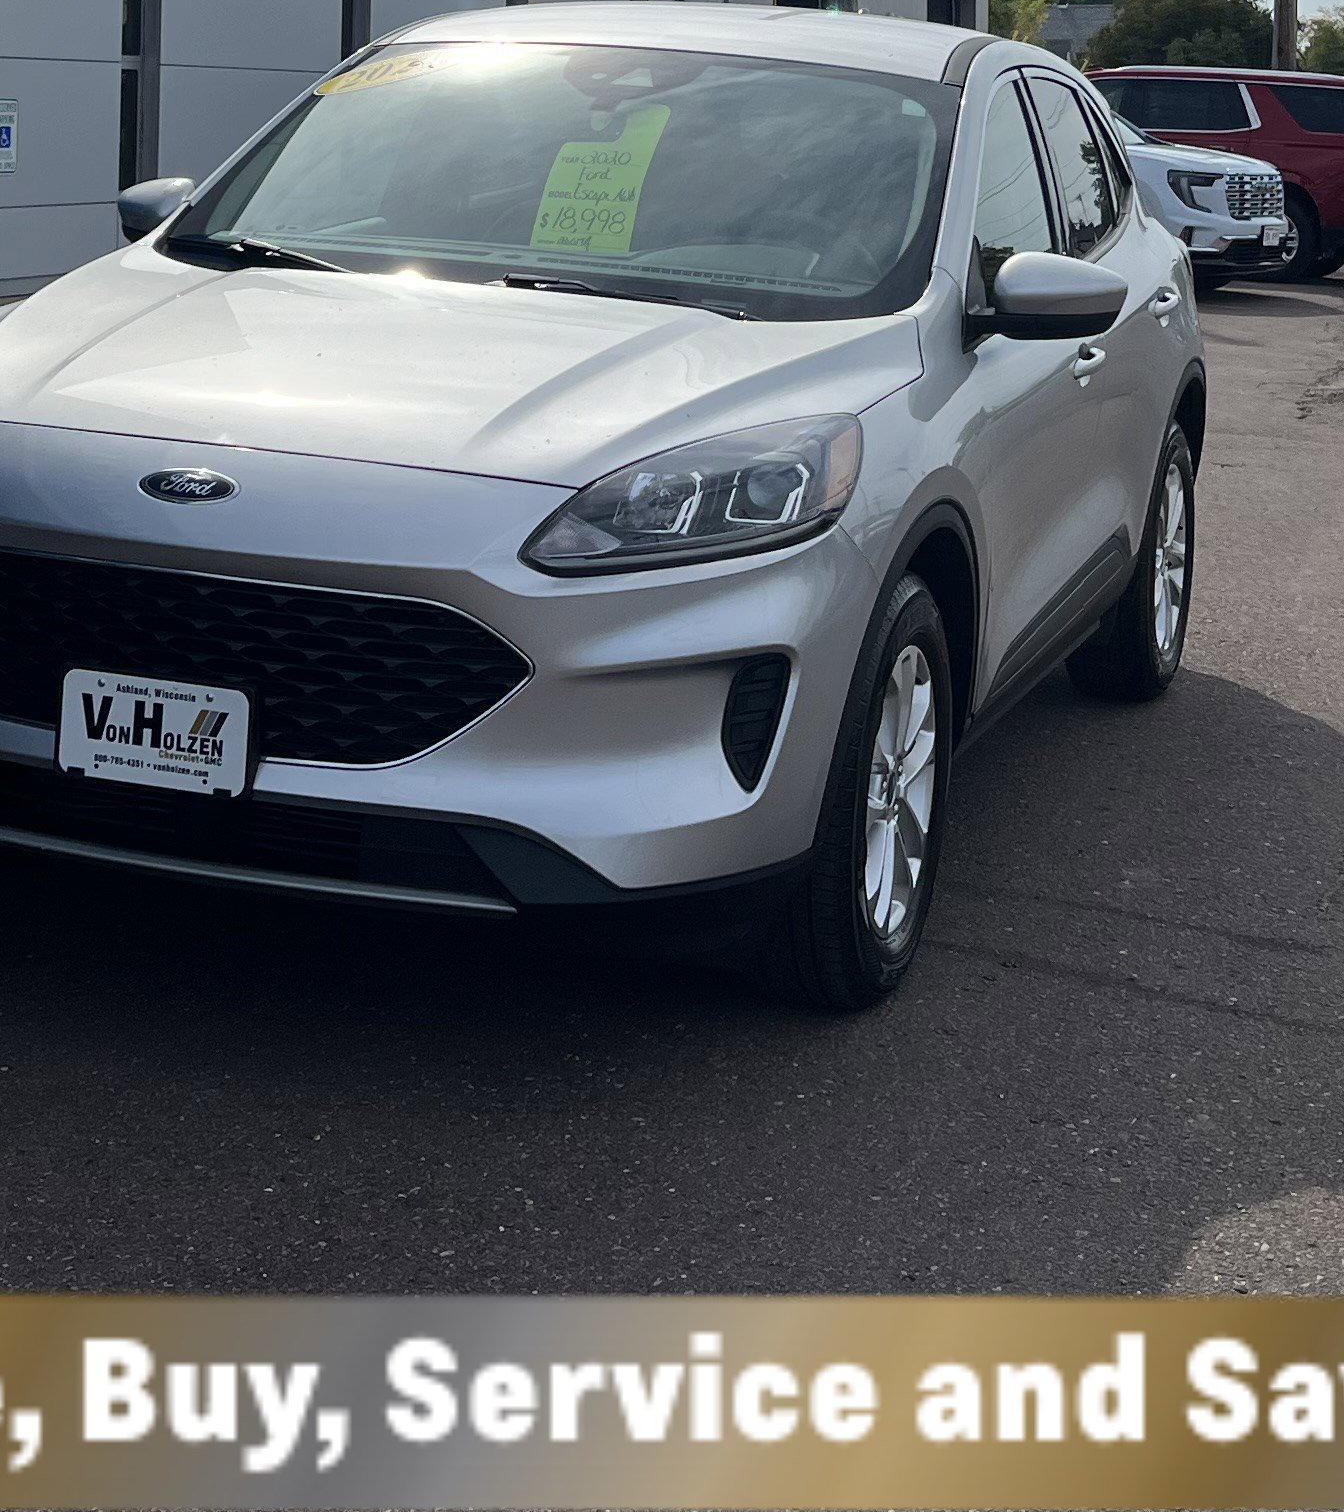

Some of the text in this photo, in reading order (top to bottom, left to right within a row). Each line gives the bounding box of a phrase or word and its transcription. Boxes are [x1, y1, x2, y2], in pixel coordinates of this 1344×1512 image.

[578, 166, 613, 181] Ford
[160, 472, 217, 496] Ford
[115, 682, 197, 703] Ashland, Wisconsin
